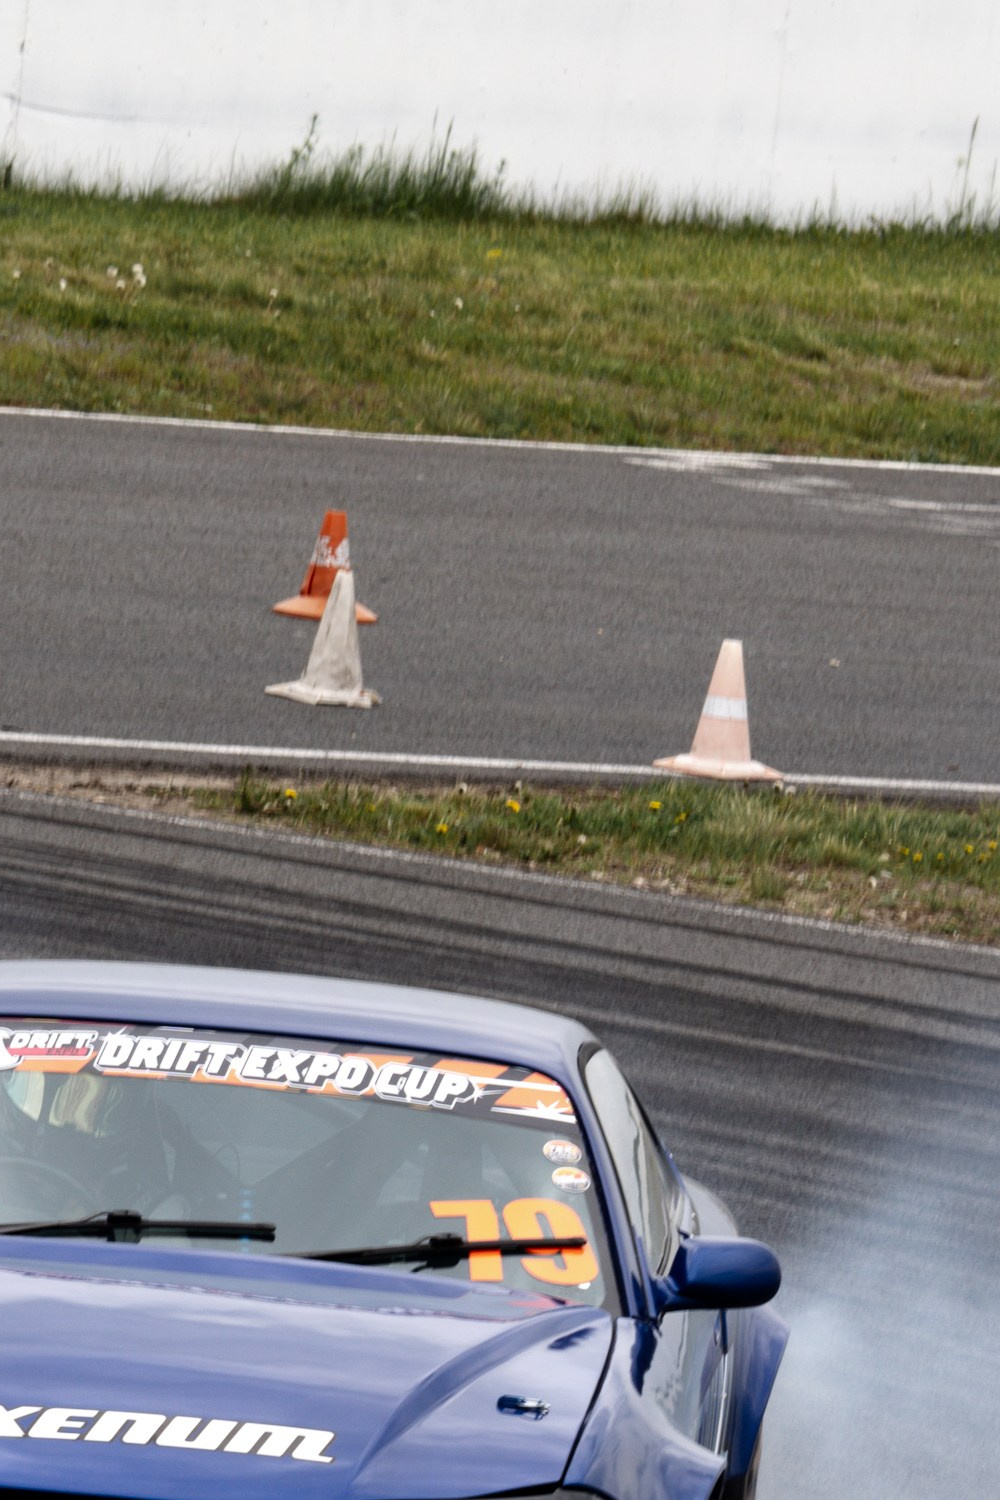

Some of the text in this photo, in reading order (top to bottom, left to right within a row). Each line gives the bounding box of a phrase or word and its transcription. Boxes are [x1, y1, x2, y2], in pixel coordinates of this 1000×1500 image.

[9, 1031, 90, 1049] DRIFT
[99, 1036, 470, 1103] DRIFT EXPO CUP
[429, 1198, 599, 1286] 79
